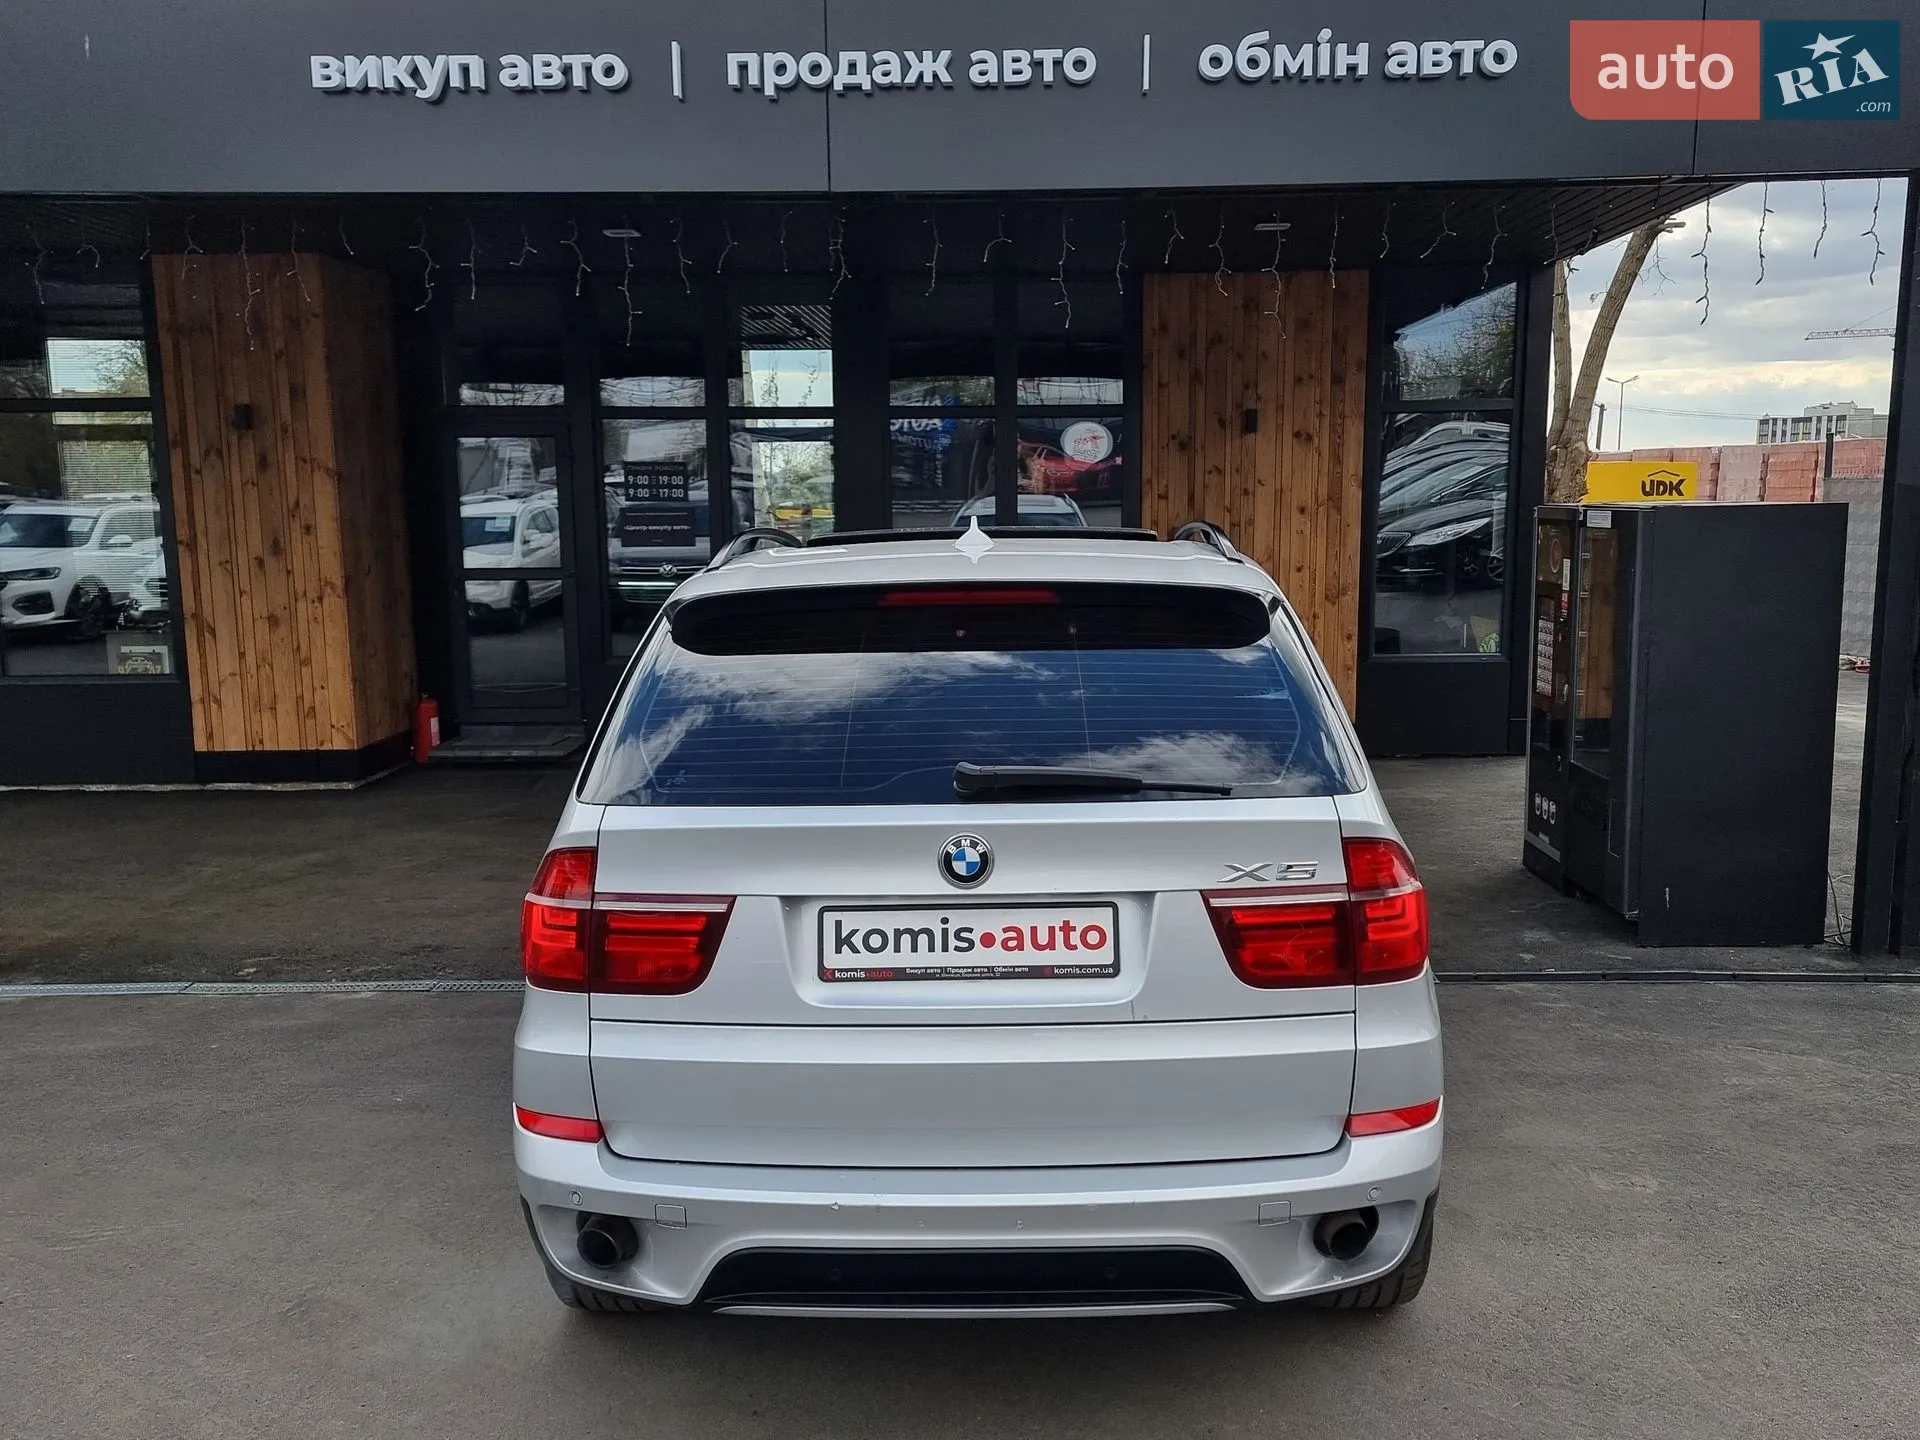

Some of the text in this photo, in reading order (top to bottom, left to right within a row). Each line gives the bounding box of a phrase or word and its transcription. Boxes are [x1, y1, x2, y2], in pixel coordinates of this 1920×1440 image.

[1198, 28, 1519, 82] обмін авто
[309, 52, 630, 101] викуп авто
[726, 46, 1097, 99] продаж авто
[628, 475, 649, 485] 9:00
[658, 475, 684, 485] 19:00
[1641, 478, 1688, 497] UDK
[628, 488, 650, 498] 9:00
[659, 488, 684, 498] 17:00
[947, 838, 986, 854] BMW
[1216, 861, 1320, 883] X5
[1054, 966, 1114, 975] komis.com.ua
